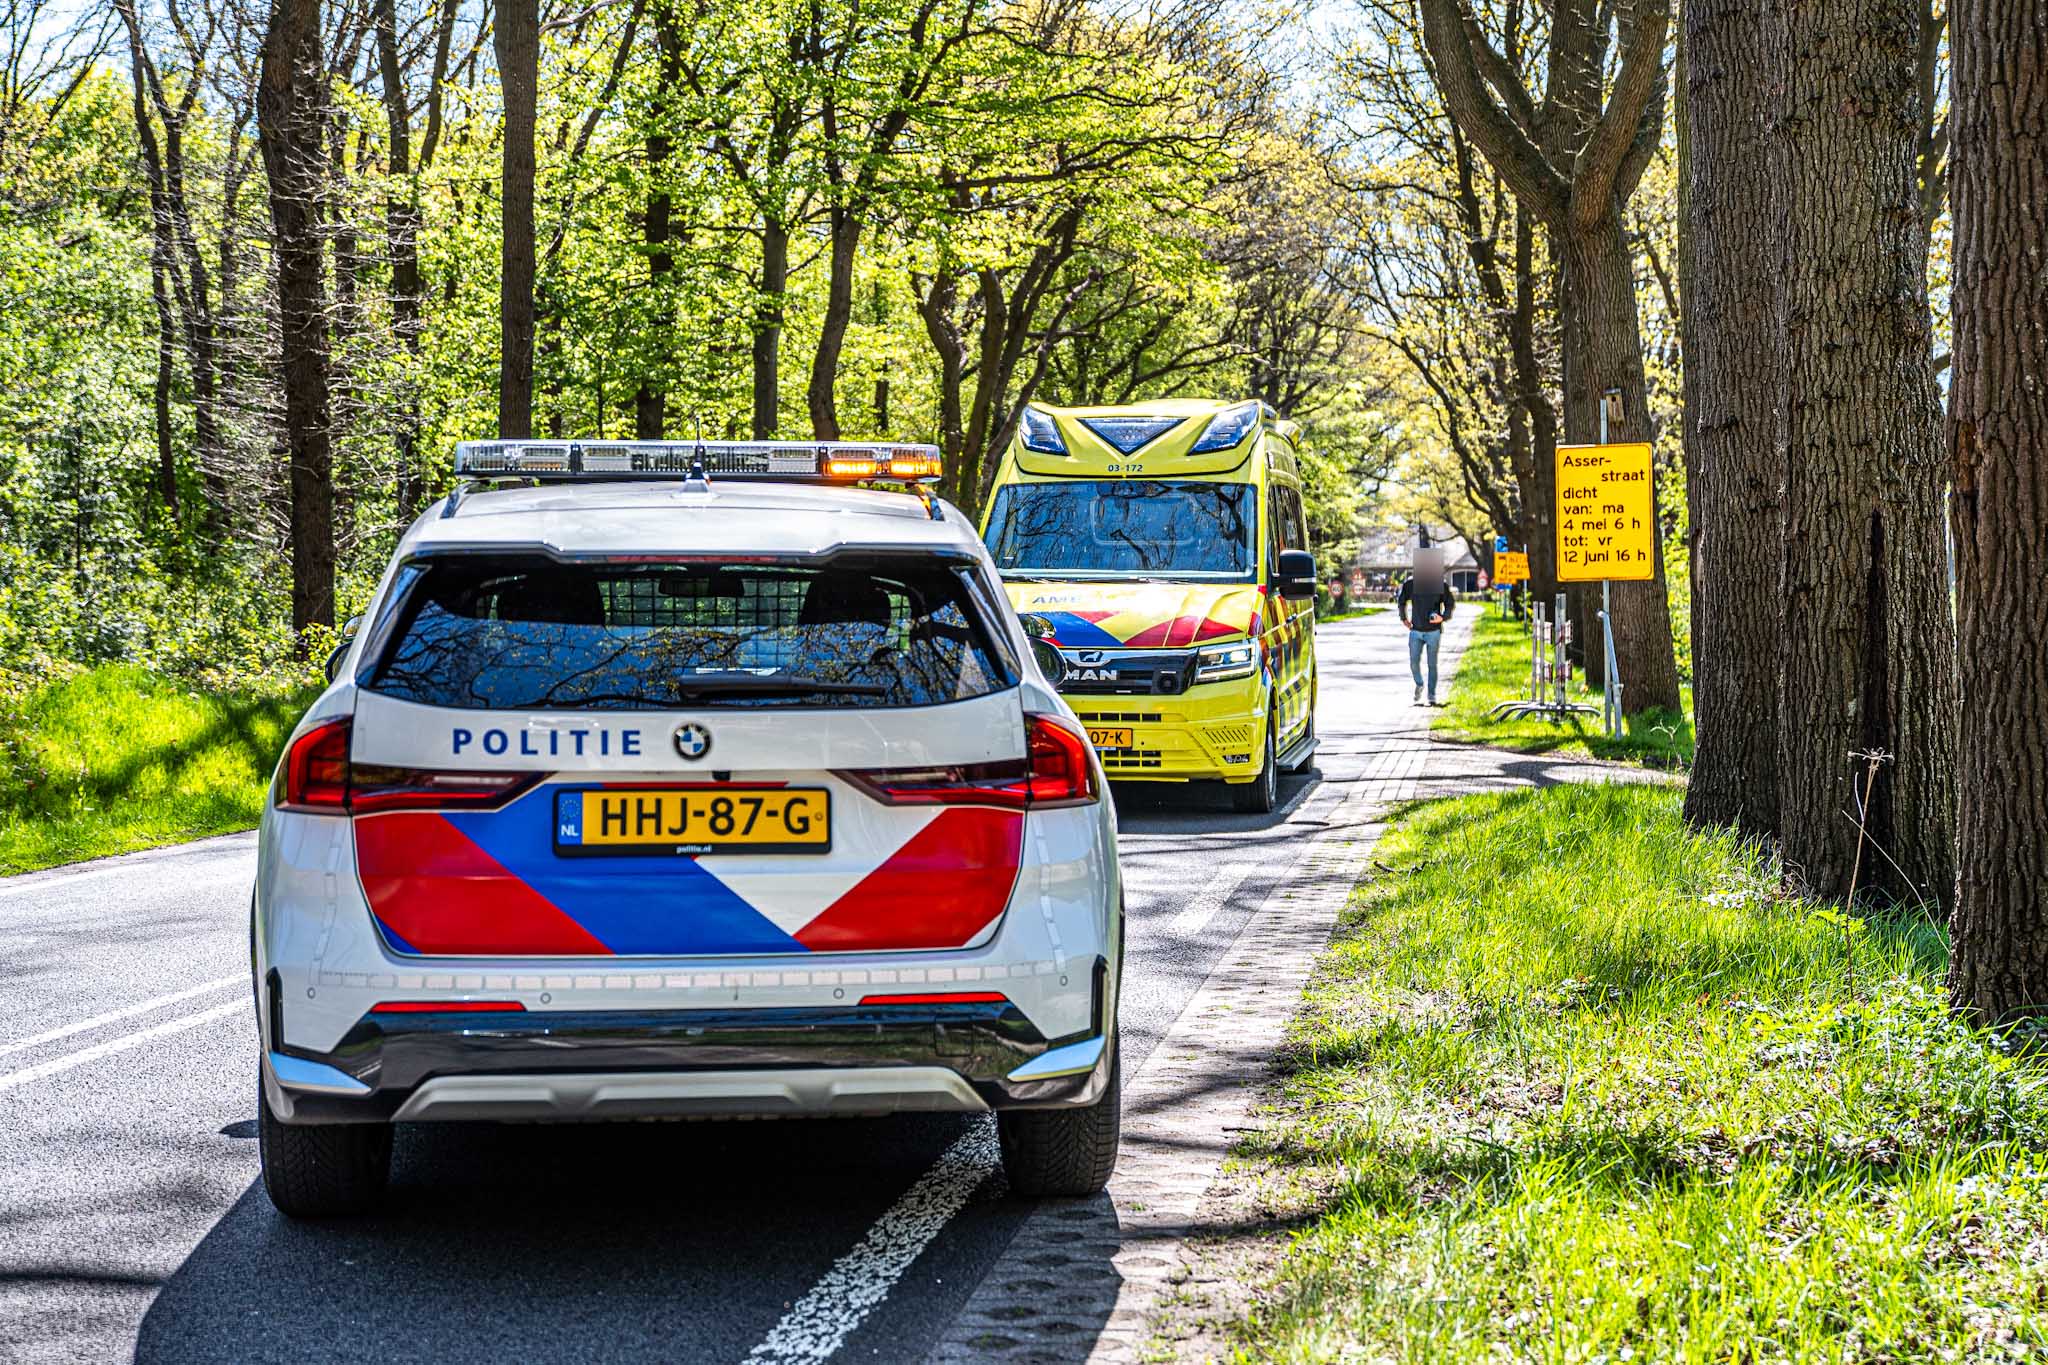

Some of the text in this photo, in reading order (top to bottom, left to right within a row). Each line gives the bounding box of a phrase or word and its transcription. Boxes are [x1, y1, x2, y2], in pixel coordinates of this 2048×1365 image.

[1563, 455, 1612, 467] Asser-
[1601, 469, 1645, 482] straat
[1563, 486, 1598, 499] dicht
[1563, 504, 1625, 515] van: ma
[1563, 517, 1641, 530] 4 mei 6 h
[1564, 535, 1613, 547] tot: vr
[1564, 549, 1646, 566] 12 juni 16 h
[1064, 669, 1118, 681] MAN
[452, 729, 641, 755] POLITIE
[601, 797, 810, 836] HHJ-87-G
[560, 825, 579, 836] NL
